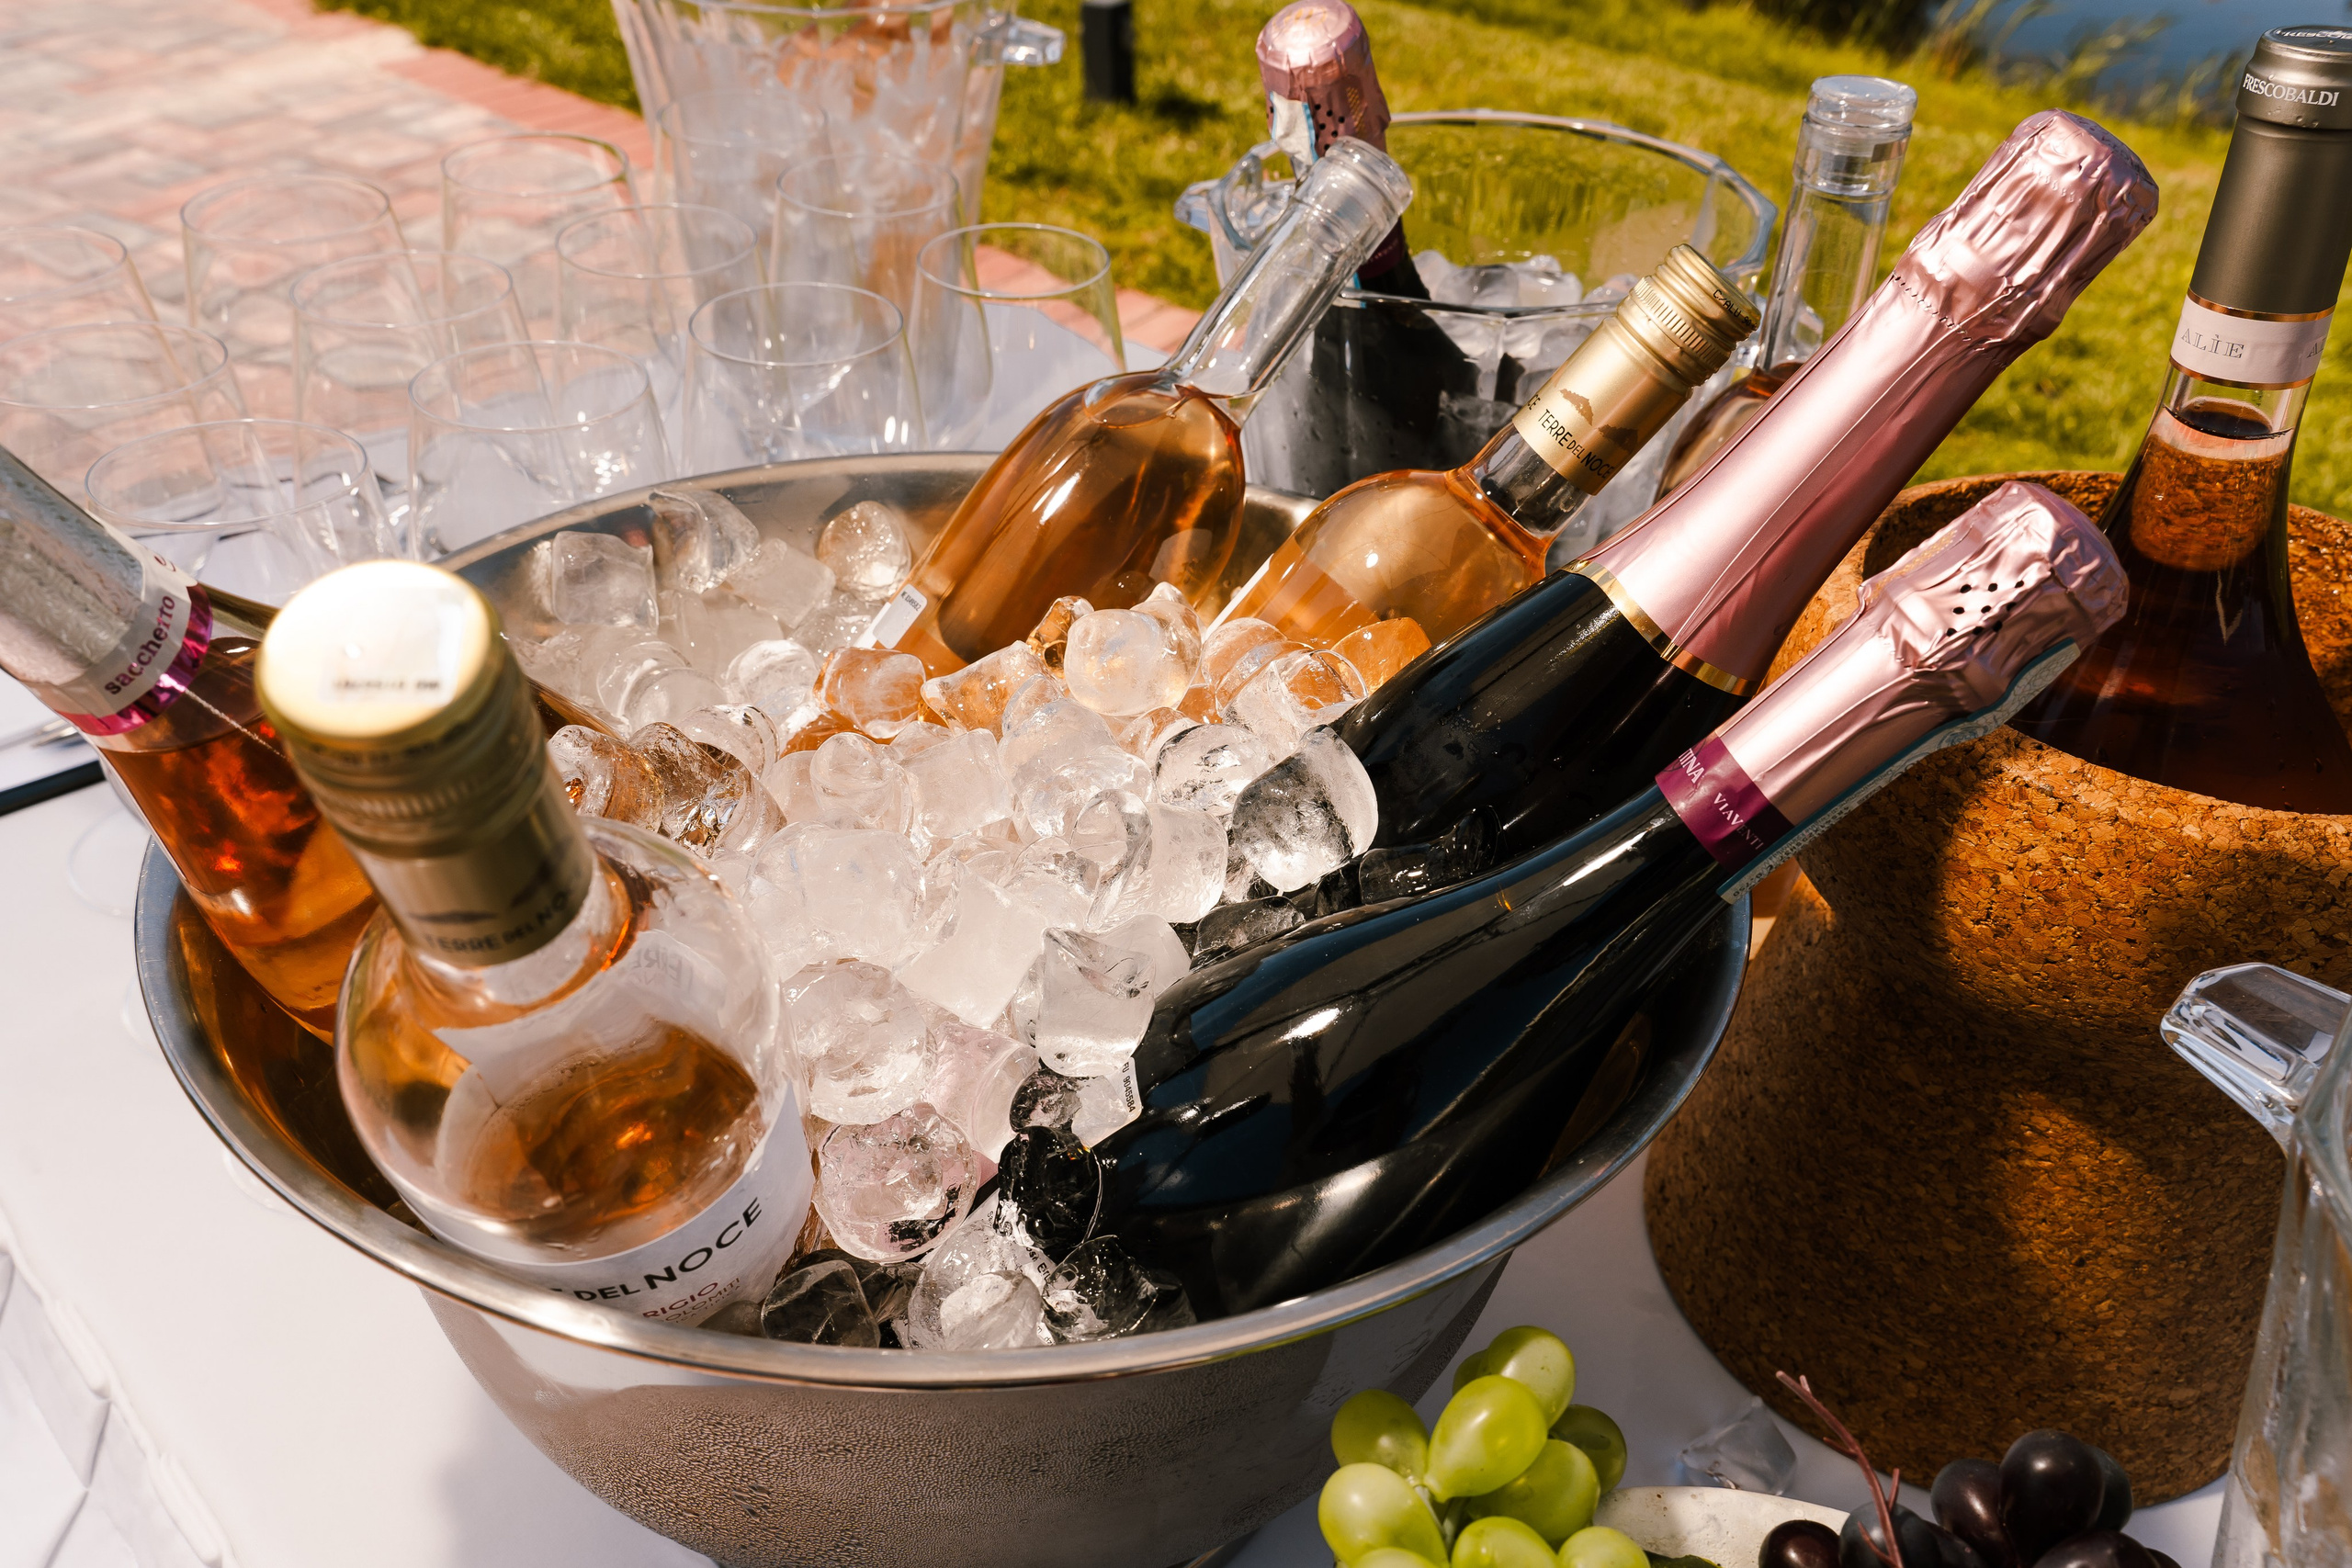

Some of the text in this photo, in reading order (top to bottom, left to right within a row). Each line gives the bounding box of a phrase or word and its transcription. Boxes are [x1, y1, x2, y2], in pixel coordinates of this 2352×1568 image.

[2243, 73, 2340, 107] FRESCOBALDI
[1538, 409, 1615, 479] TERRE DEL NOCE
[1713, 792, 1764, 851] VIAVENTI
[573, 1196, 762, 1302] DEL NOCE
[643, 1282, 718, 1318] RIGIO
[665, 1278, 740, 1322] OLOMITI
